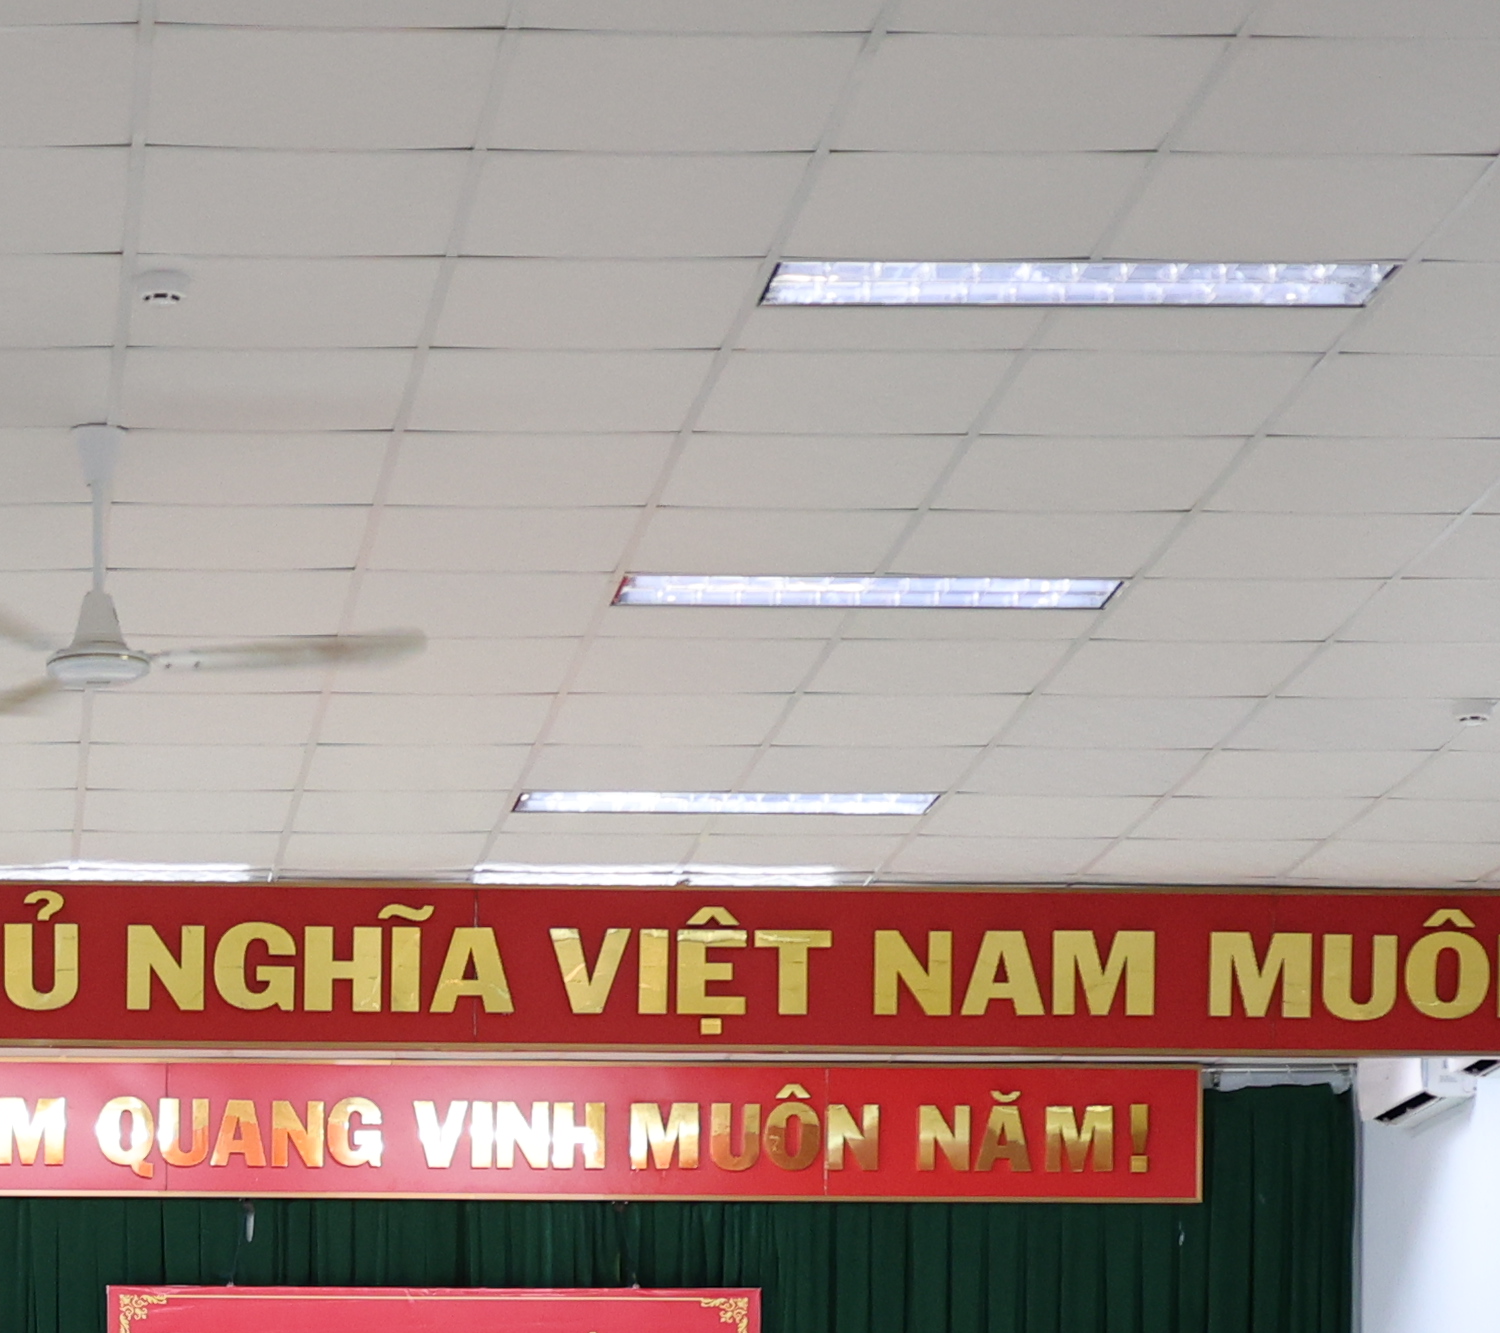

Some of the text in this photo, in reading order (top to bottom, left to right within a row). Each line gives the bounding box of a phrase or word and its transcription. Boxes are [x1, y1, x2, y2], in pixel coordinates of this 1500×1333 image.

[127, 904, 514, 1012] NGHĨA
[550, 907, 831, 1034] VIỆT
[874, 930, 1155, 1015] NAM
[91, 1097, 385, 1173] QUANG
[414, 1101, 604, 1168] VINH
[629, 1085, 878, 1169] MUÔN
[919, 1091, 1147, 1172] NĂM!
